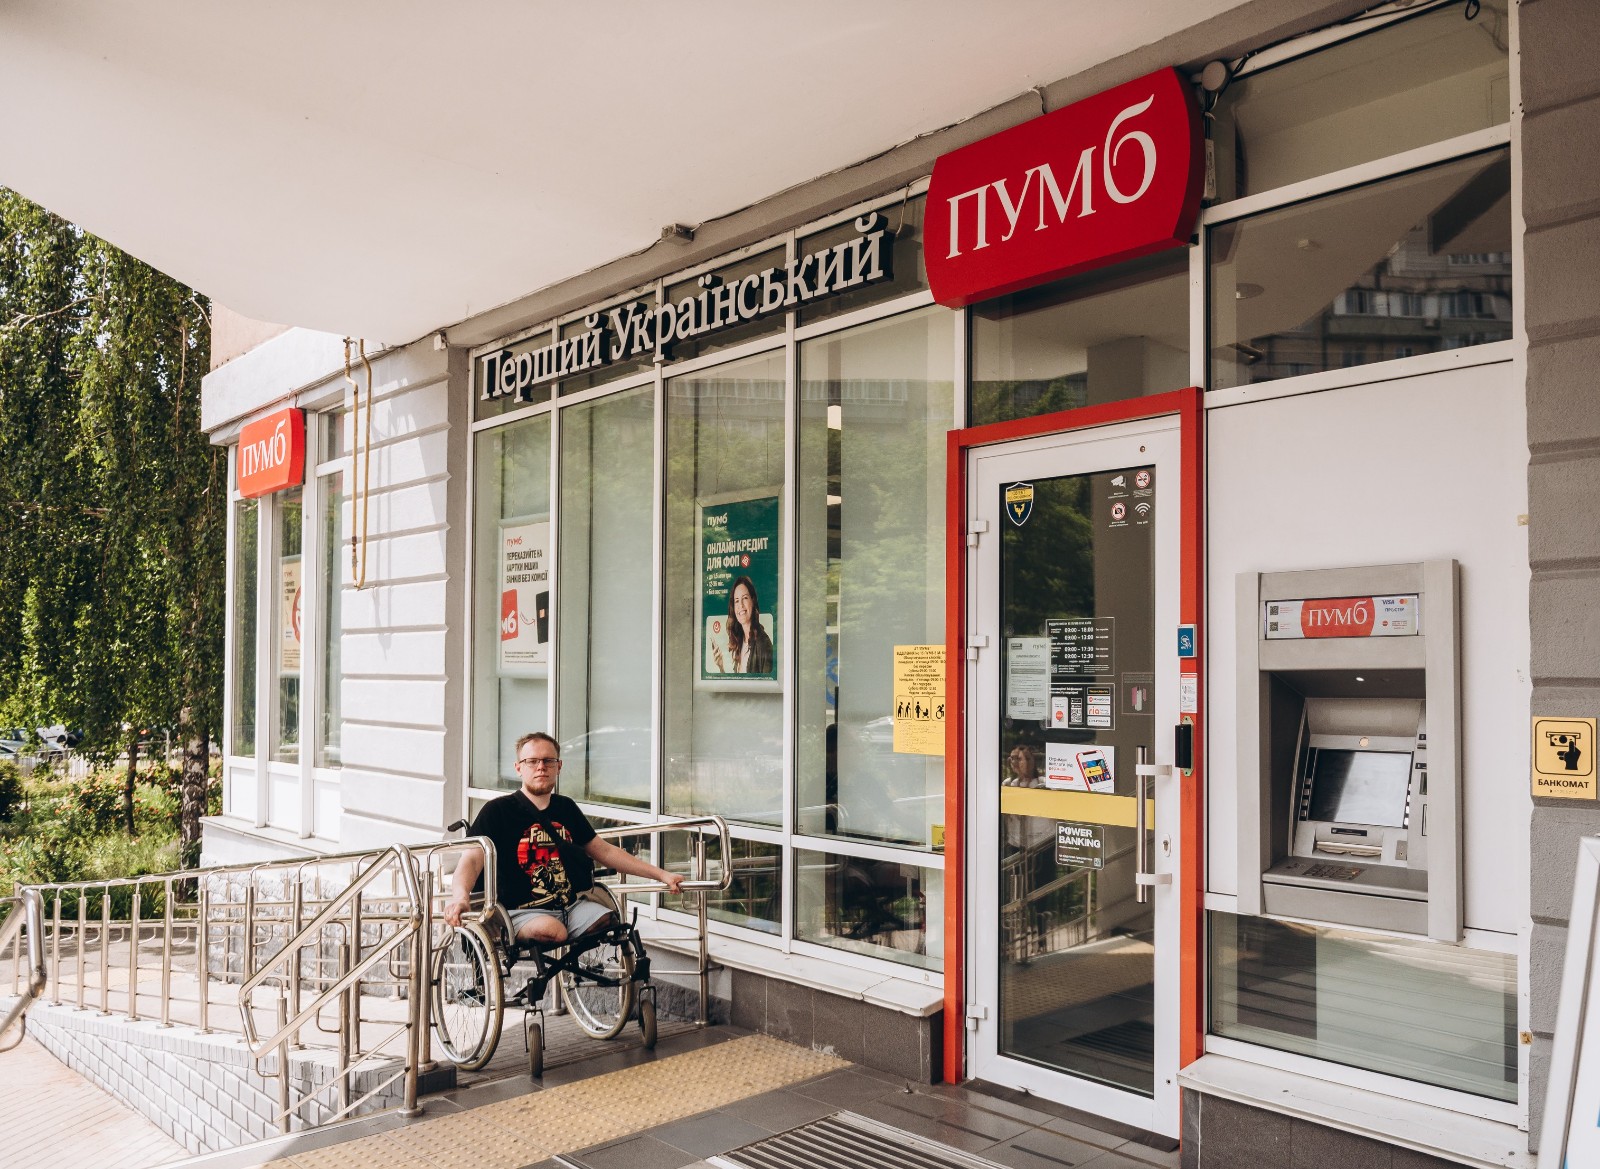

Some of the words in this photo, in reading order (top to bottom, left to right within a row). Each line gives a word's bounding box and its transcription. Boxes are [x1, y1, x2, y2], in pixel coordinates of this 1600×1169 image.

[480, 313, 602, 403] Перший
[610, 212, 886, 364] Український
[707, 512, 728, 527] пумб
[507, 536, 522, 547] пумб
[707, 538, 736, 555] ОНЛАЙН
[737, 537, 769, 552] КРЕДИТ
[706, 557, 722, 571] ДЛЯ
[723, 555, 740, 568] ФОП
[522, 574, 530, 582] БЕЗ
[1089, 706, 1100, 715] ria
[1538, 779, 1590, 789] БАНКОМАТ
[1059, 826, 1092, 838] POWER
[1059, 835, 1101, 849] BANKING
